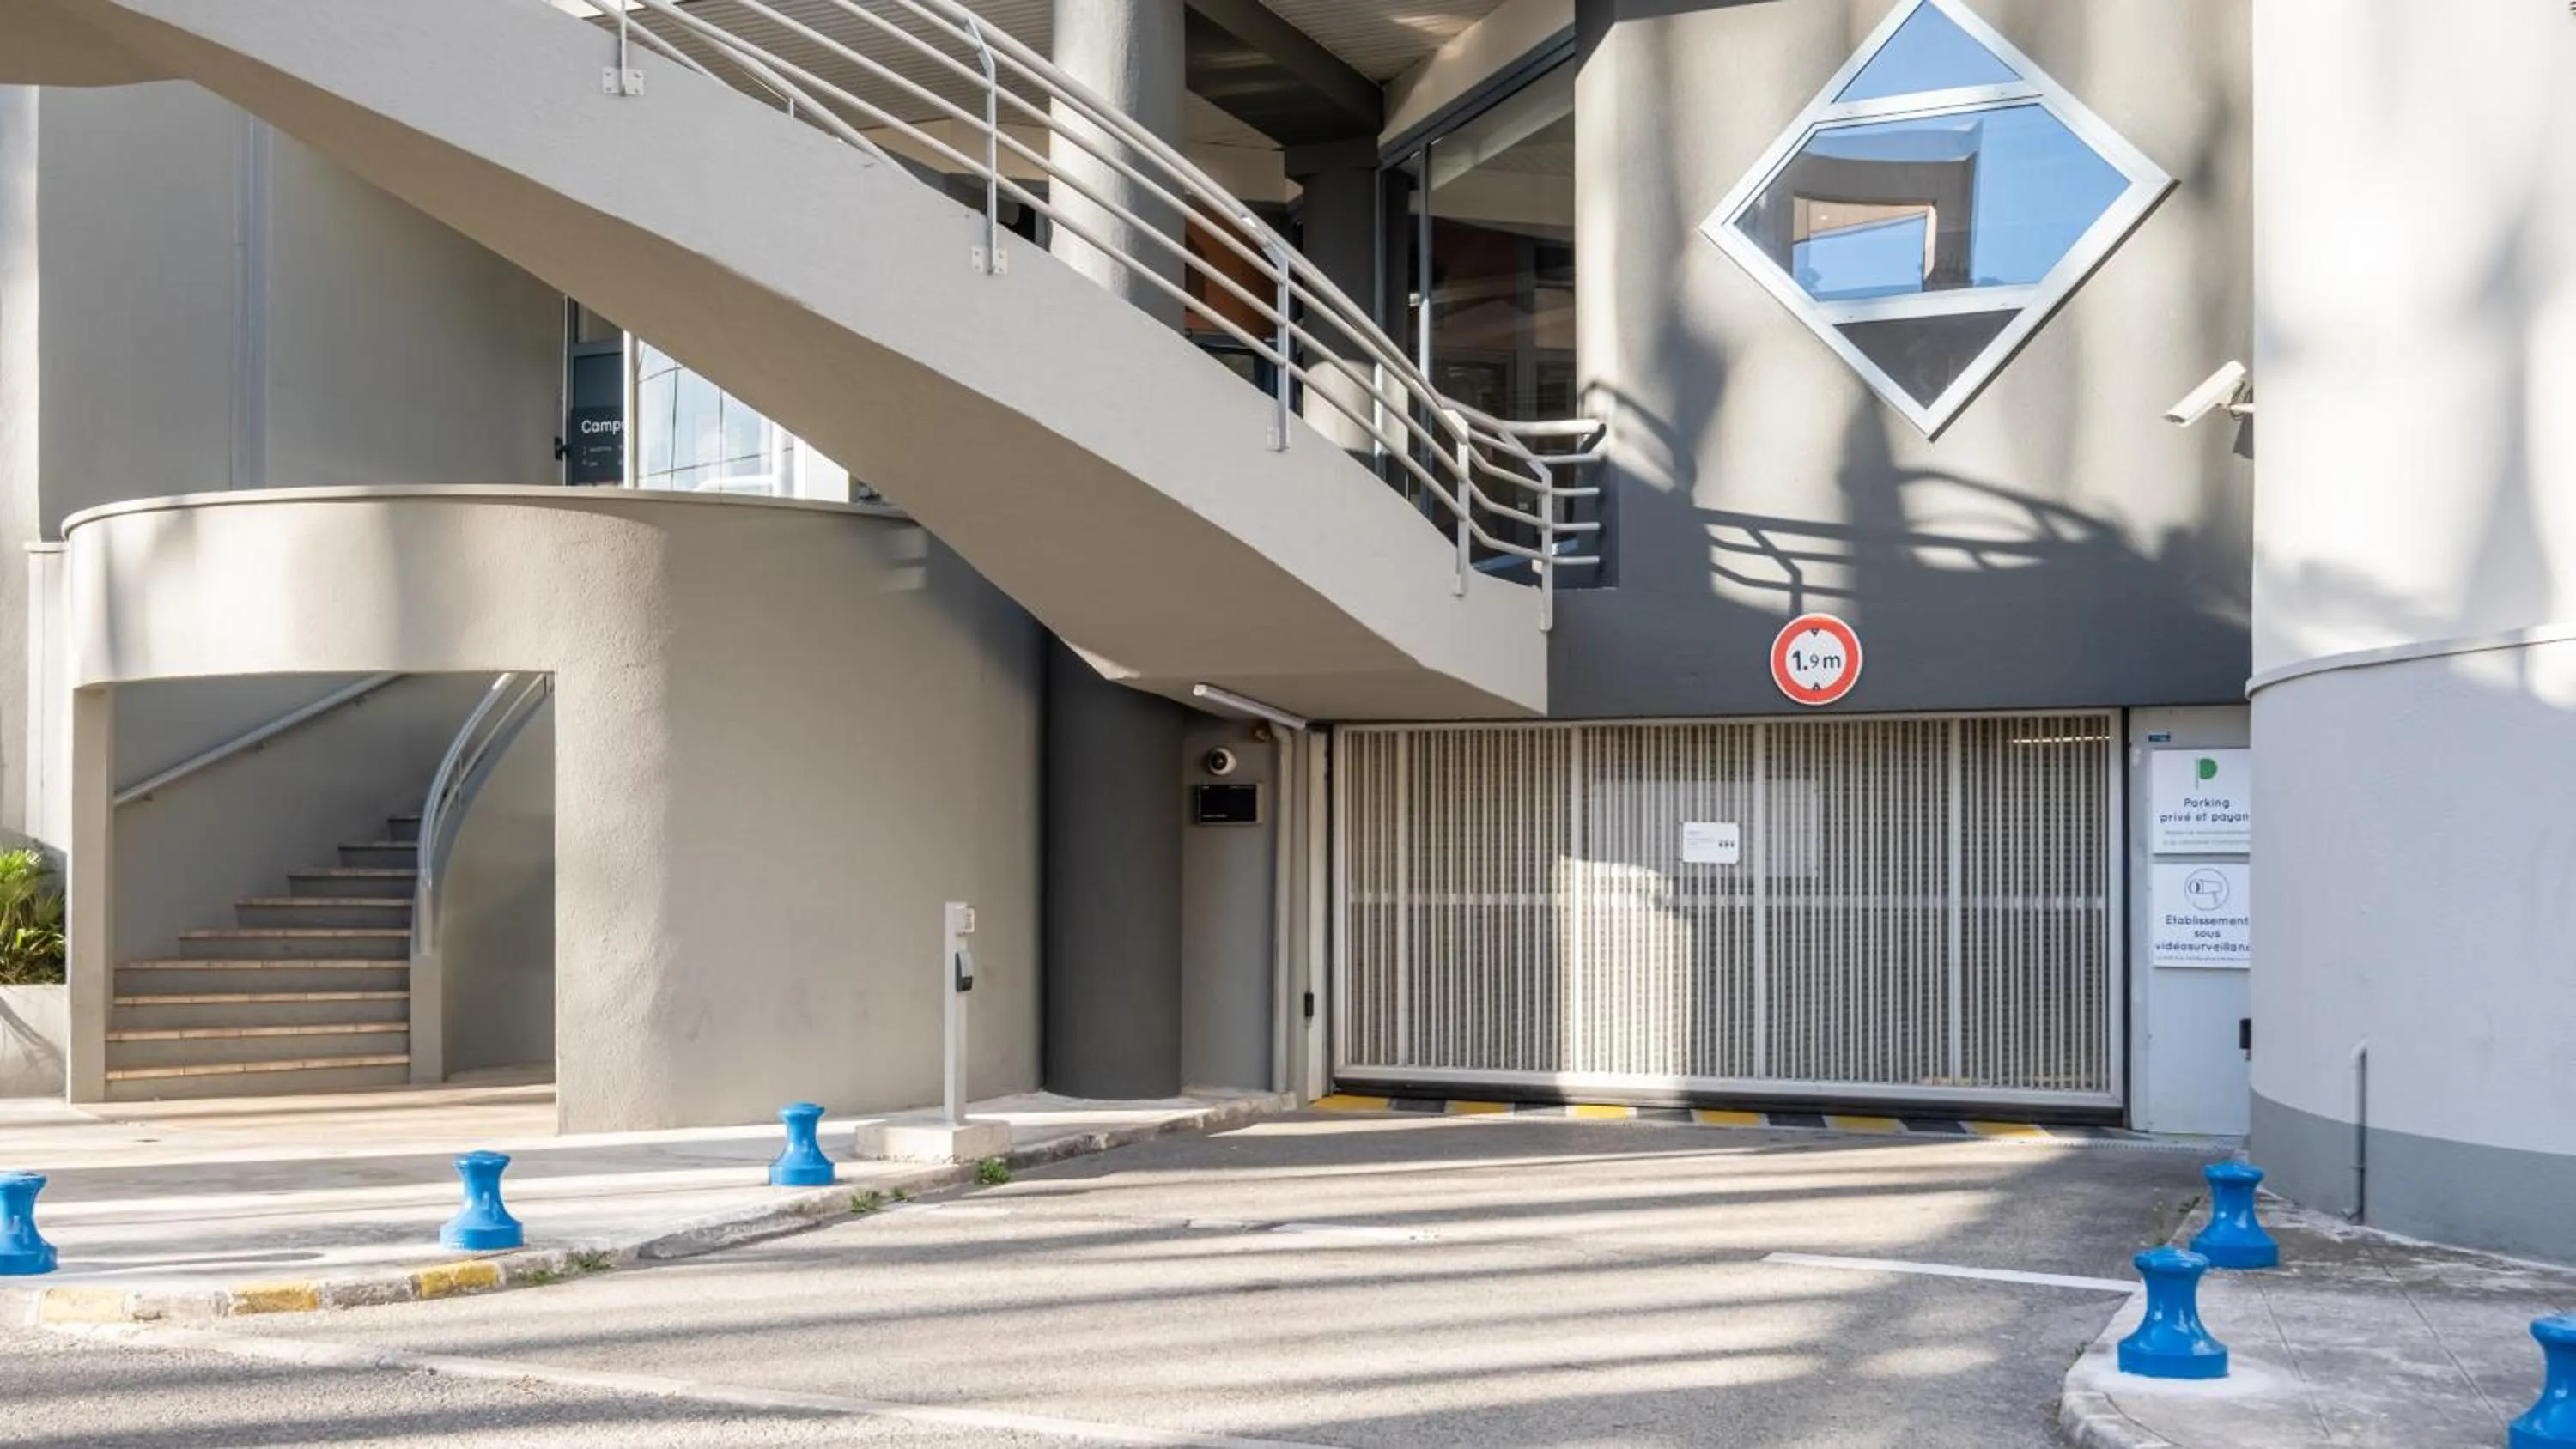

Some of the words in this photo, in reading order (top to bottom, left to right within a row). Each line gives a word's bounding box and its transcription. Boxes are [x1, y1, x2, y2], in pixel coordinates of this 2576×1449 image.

[581, 420, 624, 435] Camp
[2184, 797, 2230, 809] Parking
[2160, 813, 2191, 823] privé
[2196, 813, 2208, 822] et
[2165, 914, 2249, 925] Etablissement
[2194, 930, 2221, 938] sous
